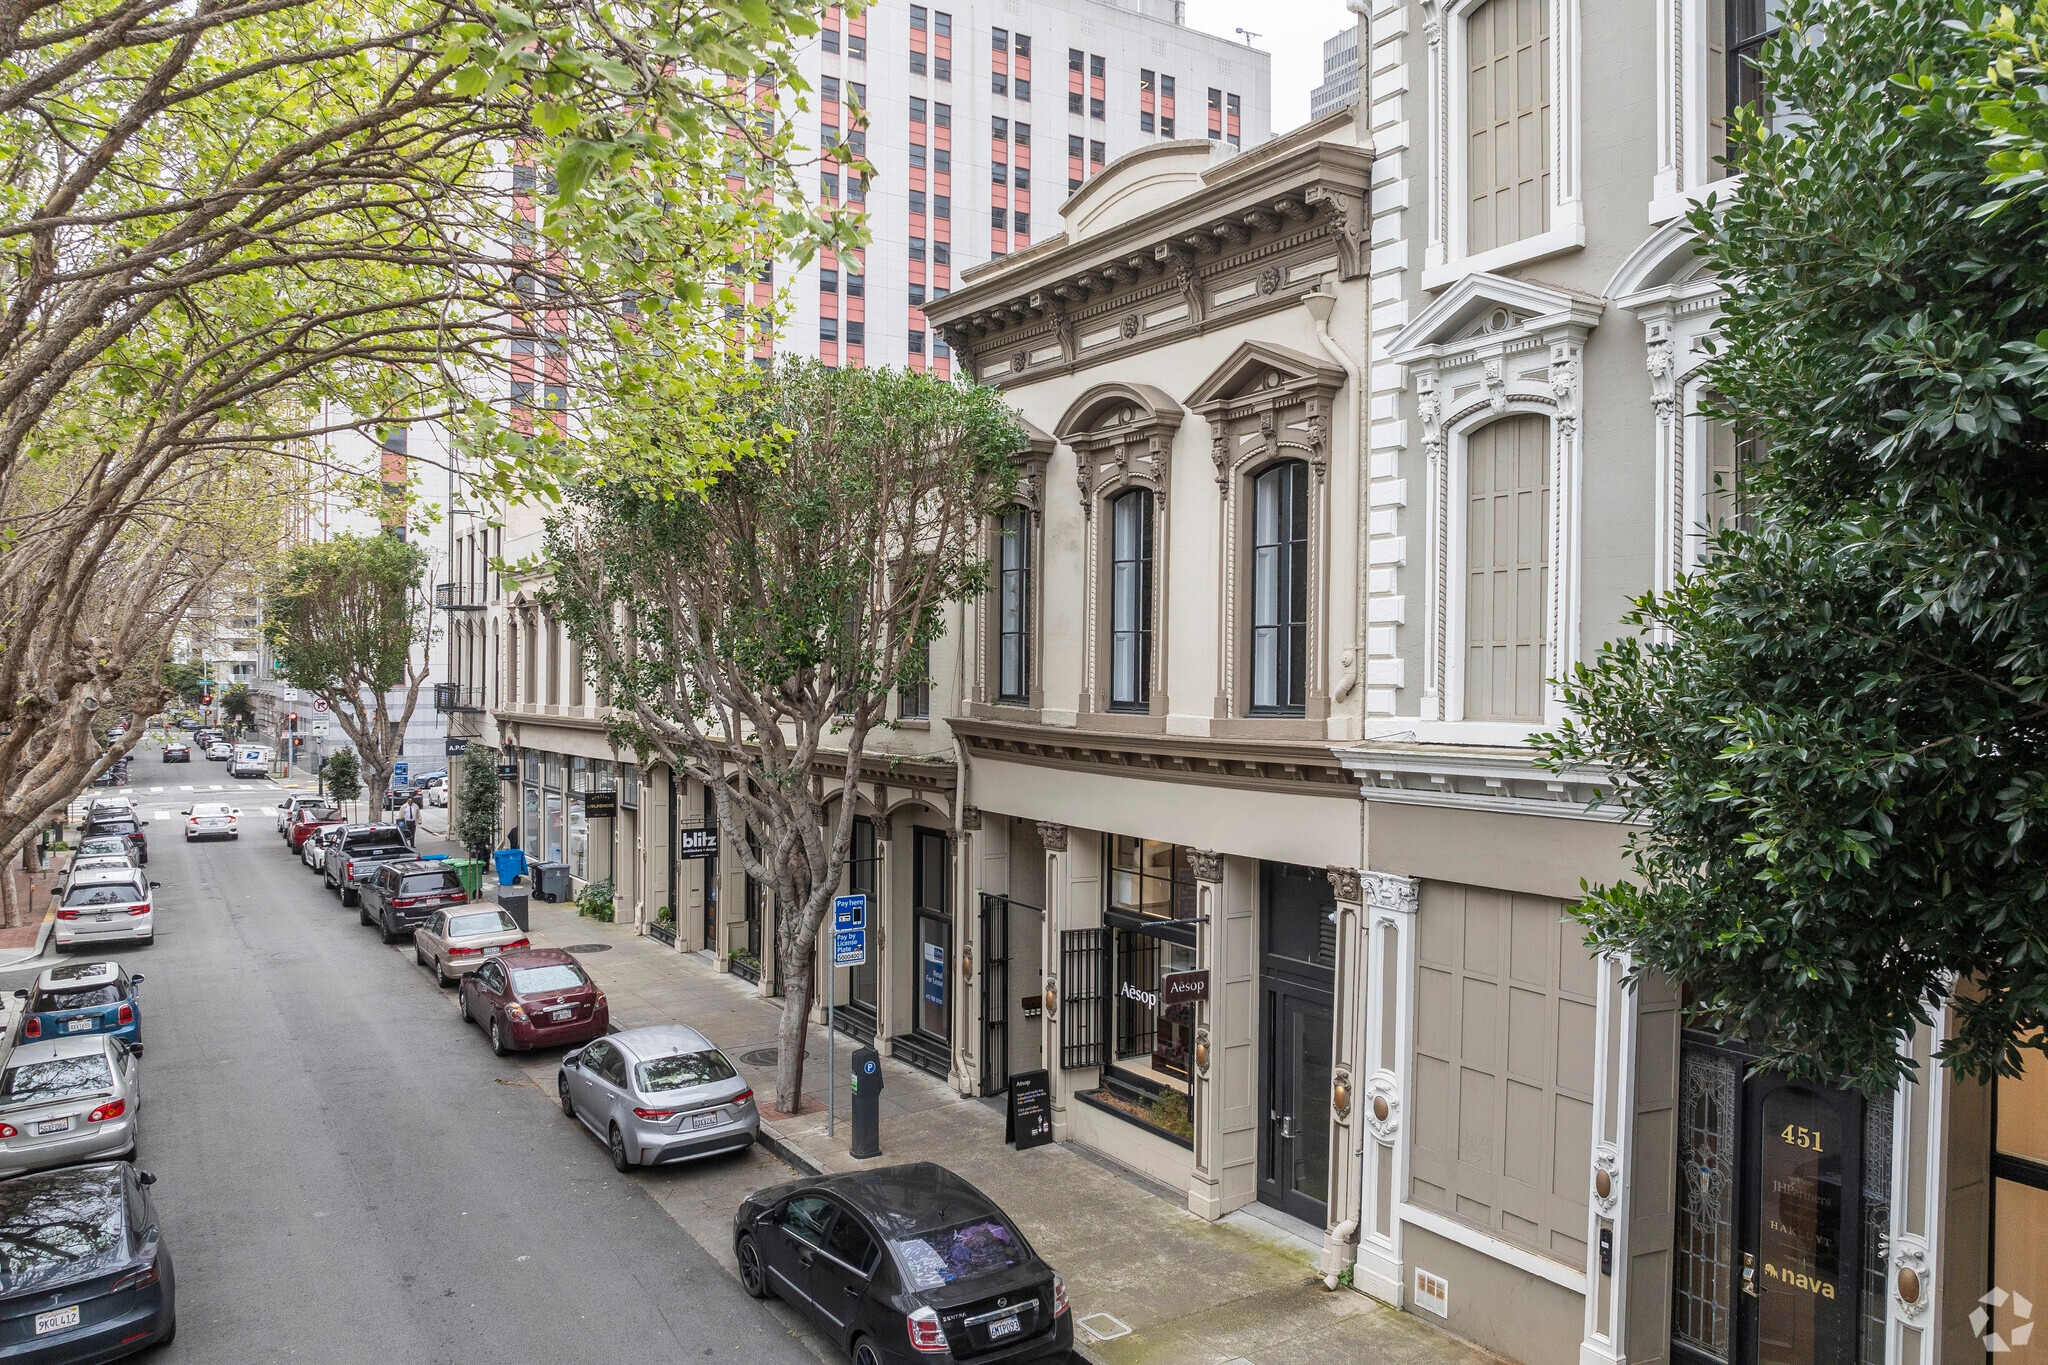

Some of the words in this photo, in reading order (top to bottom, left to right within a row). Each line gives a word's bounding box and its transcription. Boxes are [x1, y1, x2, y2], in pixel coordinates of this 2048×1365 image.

[682, 831, 717, 848] blitz
[837, 900, 849, 908] Pay
[837, 939, 858, 947] License
[932, 969, 943, 979] Retail
[932, 977, 943, 987] Lease
[1170, 981, 1205, 994] Aēsop
[1121, 981, 1156, 1010] Aēsop
[1781, 1124, 1824, 1152] 451
[1773, 1180, 1832, 1207] JHPartners
[1781, 1267, 1835, 1300] nava
[942, 1312, 968, 1323] SENTRA
